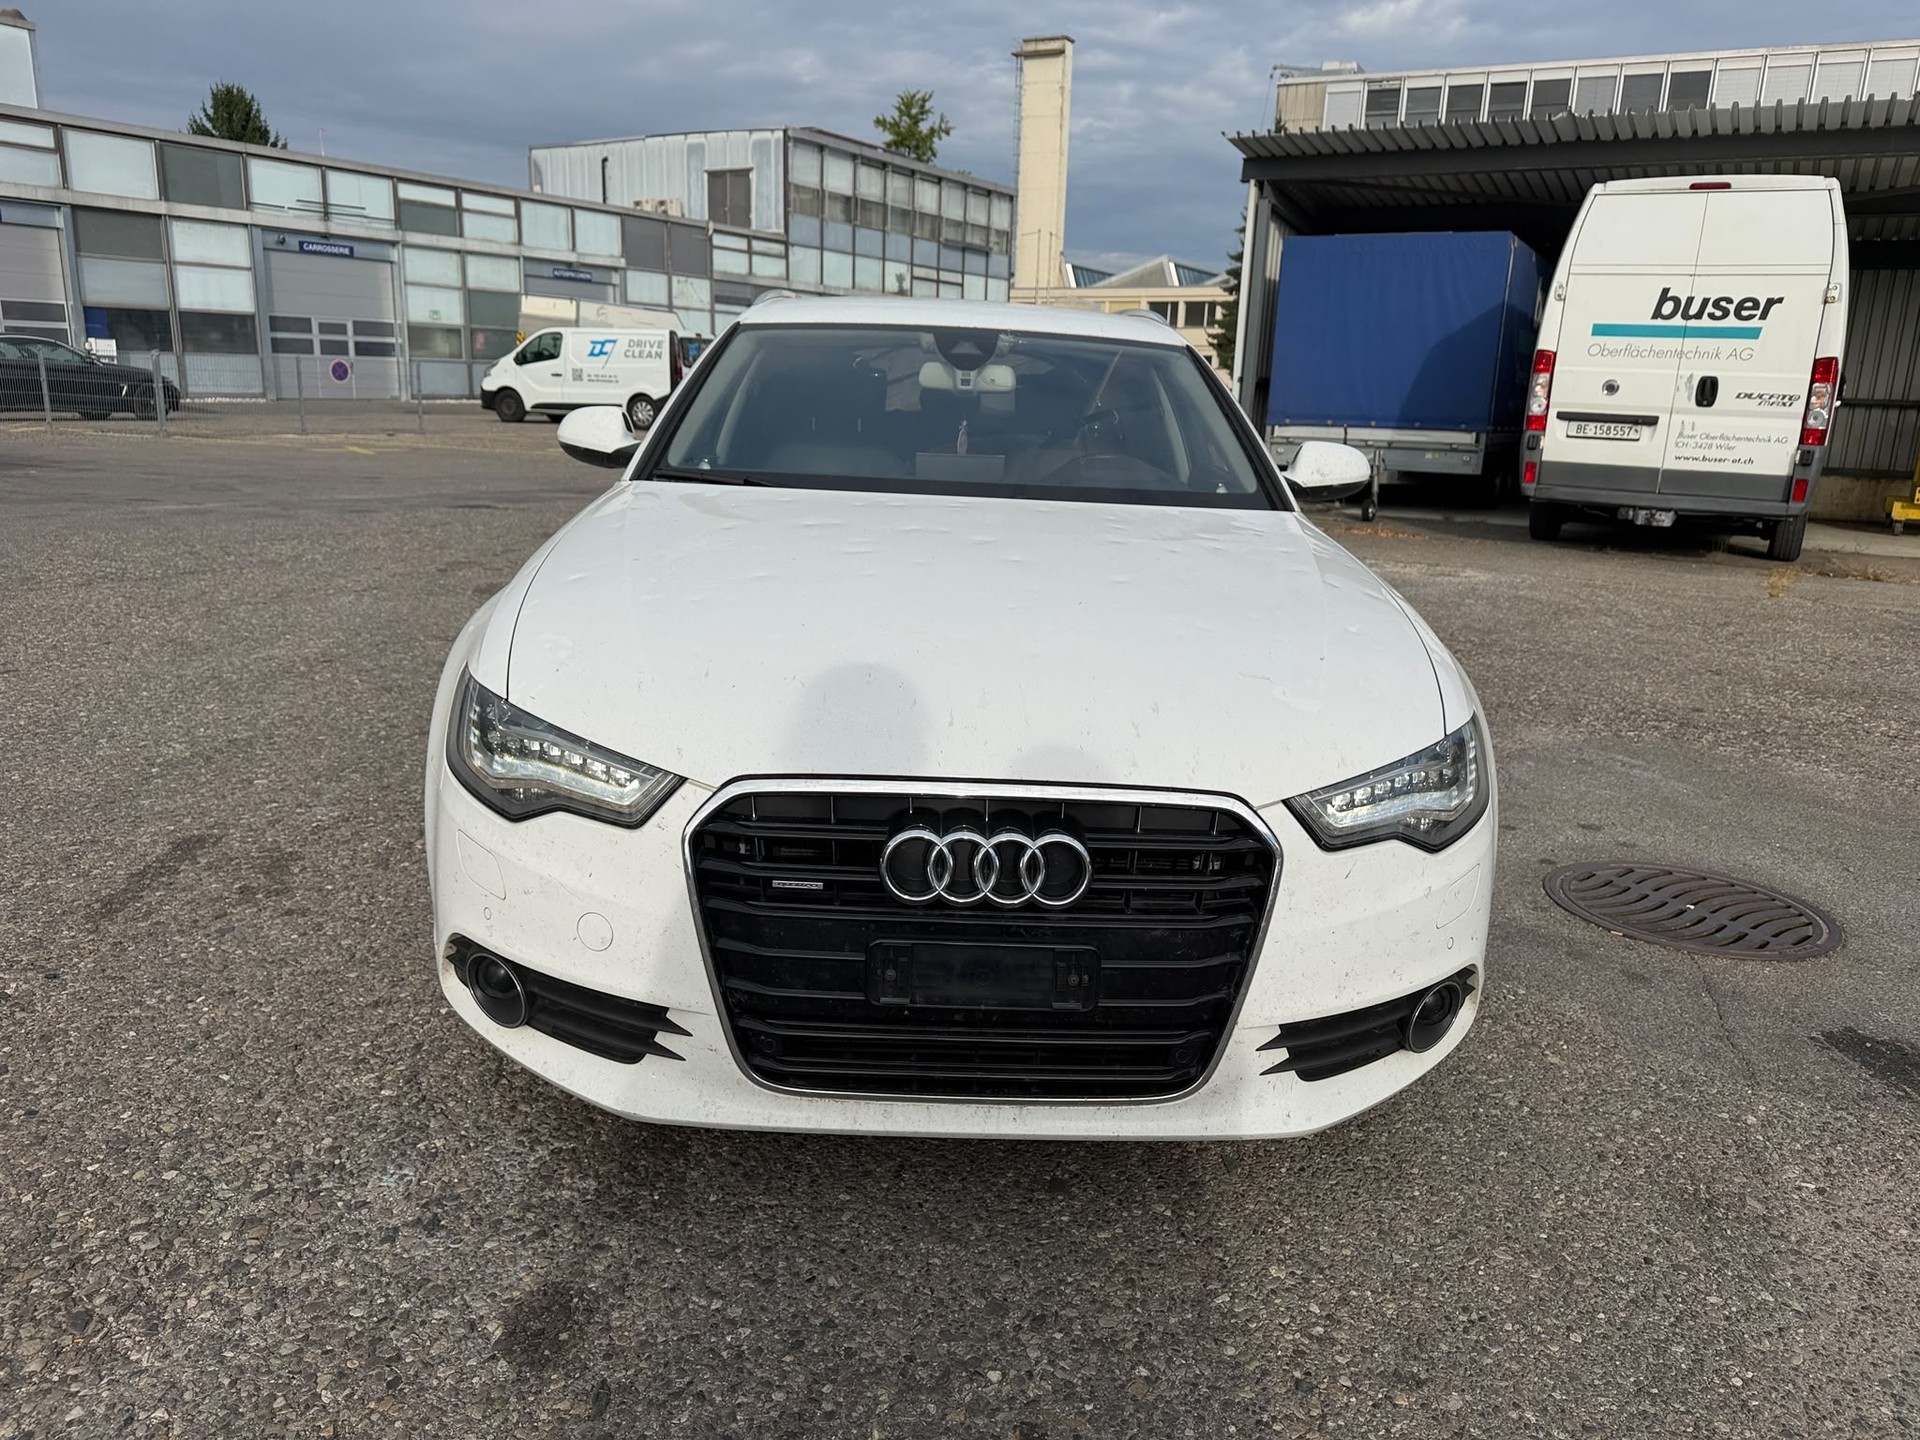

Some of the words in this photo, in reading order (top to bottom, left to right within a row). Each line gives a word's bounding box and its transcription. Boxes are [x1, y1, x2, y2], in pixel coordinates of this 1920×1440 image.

[302, 242, 350, 256] CARROSSERIE
[1650, 287, 1785, 322] buser
[627, 338, 664, 349] DRIVE
[623, 349, 663, 360] CLEAN
[1586, 342, 1722, 361] Oberflächentechnik
[1725, 347, 1755, 361] AG
[1735, 391, 1801, 402] DUCATO
[1677, 431, 1697, 440] Buser
[1773, 436, 1789, 444] AG
[1674, 454, 1754, 465] www.buser-ot.ch
